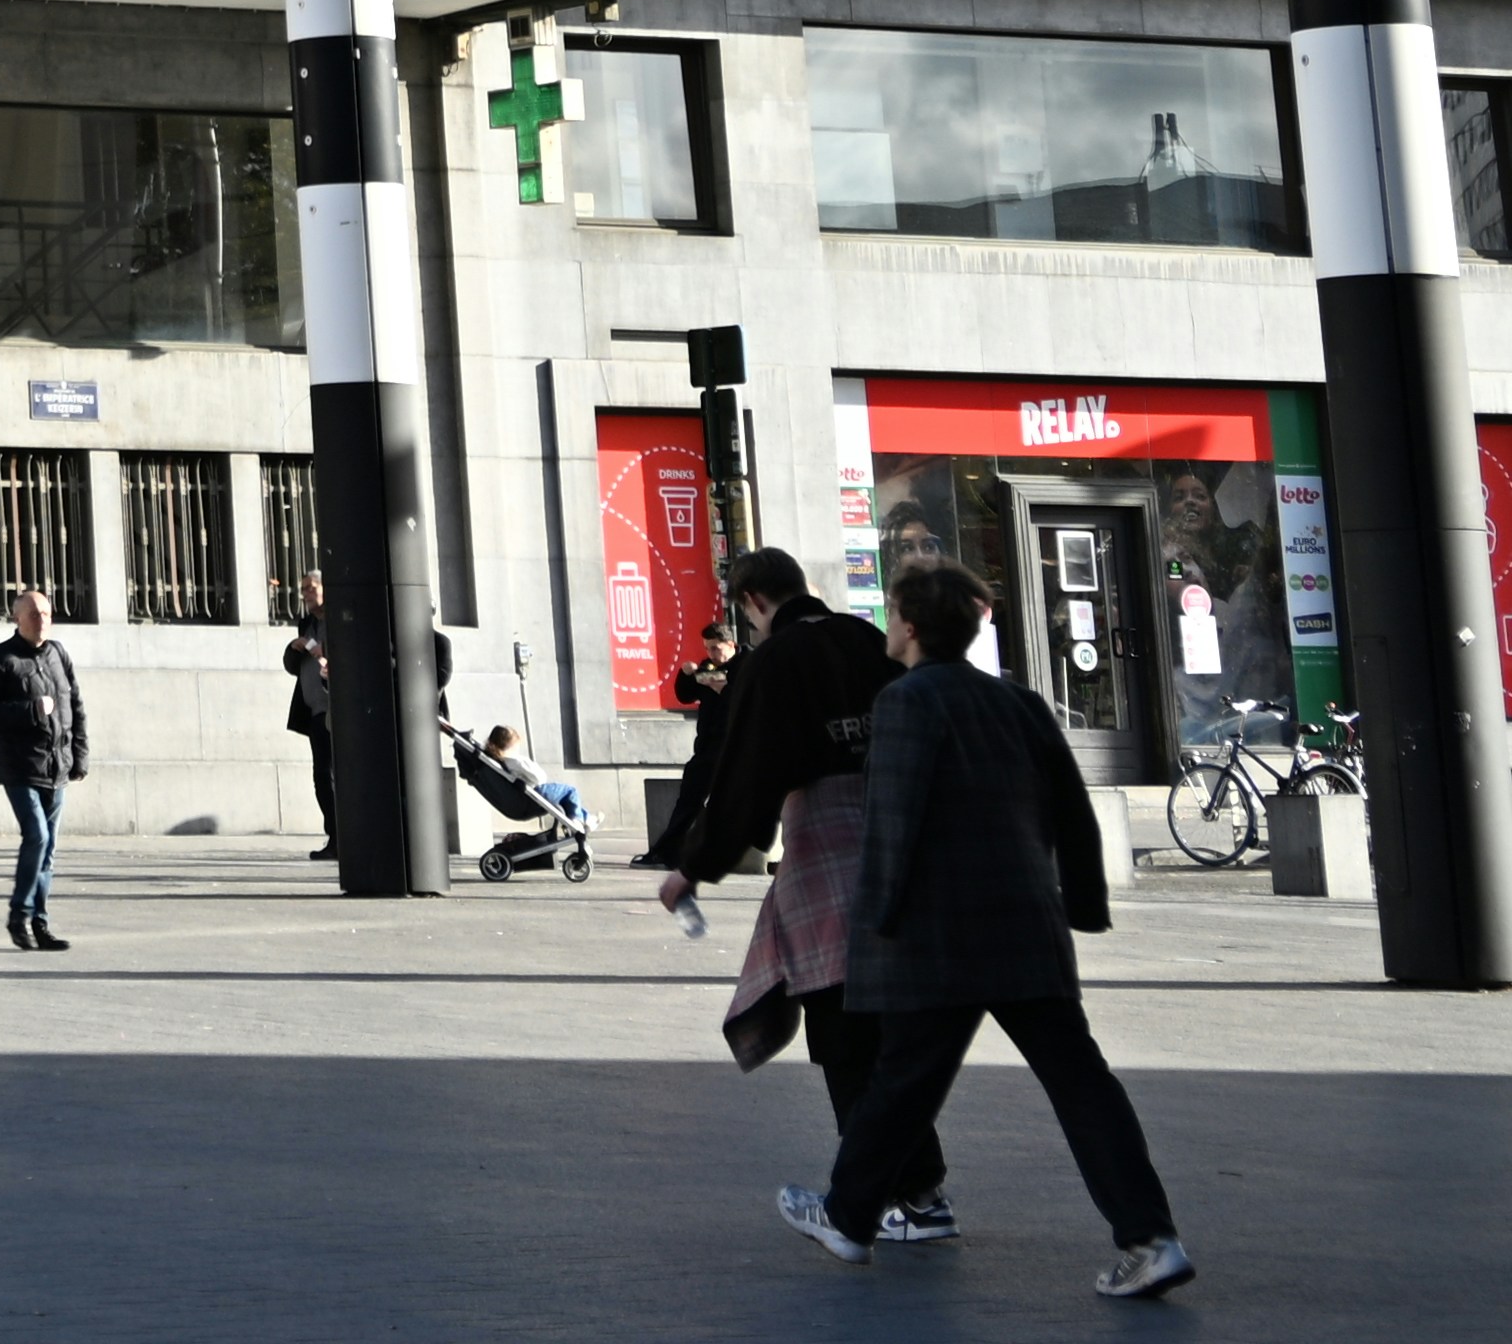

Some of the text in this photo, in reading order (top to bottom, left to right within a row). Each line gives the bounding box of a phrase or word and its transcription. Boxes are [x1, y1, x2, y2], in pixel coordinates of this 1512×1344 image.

[658, 469, 696, 480] DRINKS
[1292, 537, 1317, 546] EURO
[1285, 545, 1326, 555] MILLIONS
[1295, 617, 1331, 630] CASH
[615, 647, 654, 660] TRAVEL
